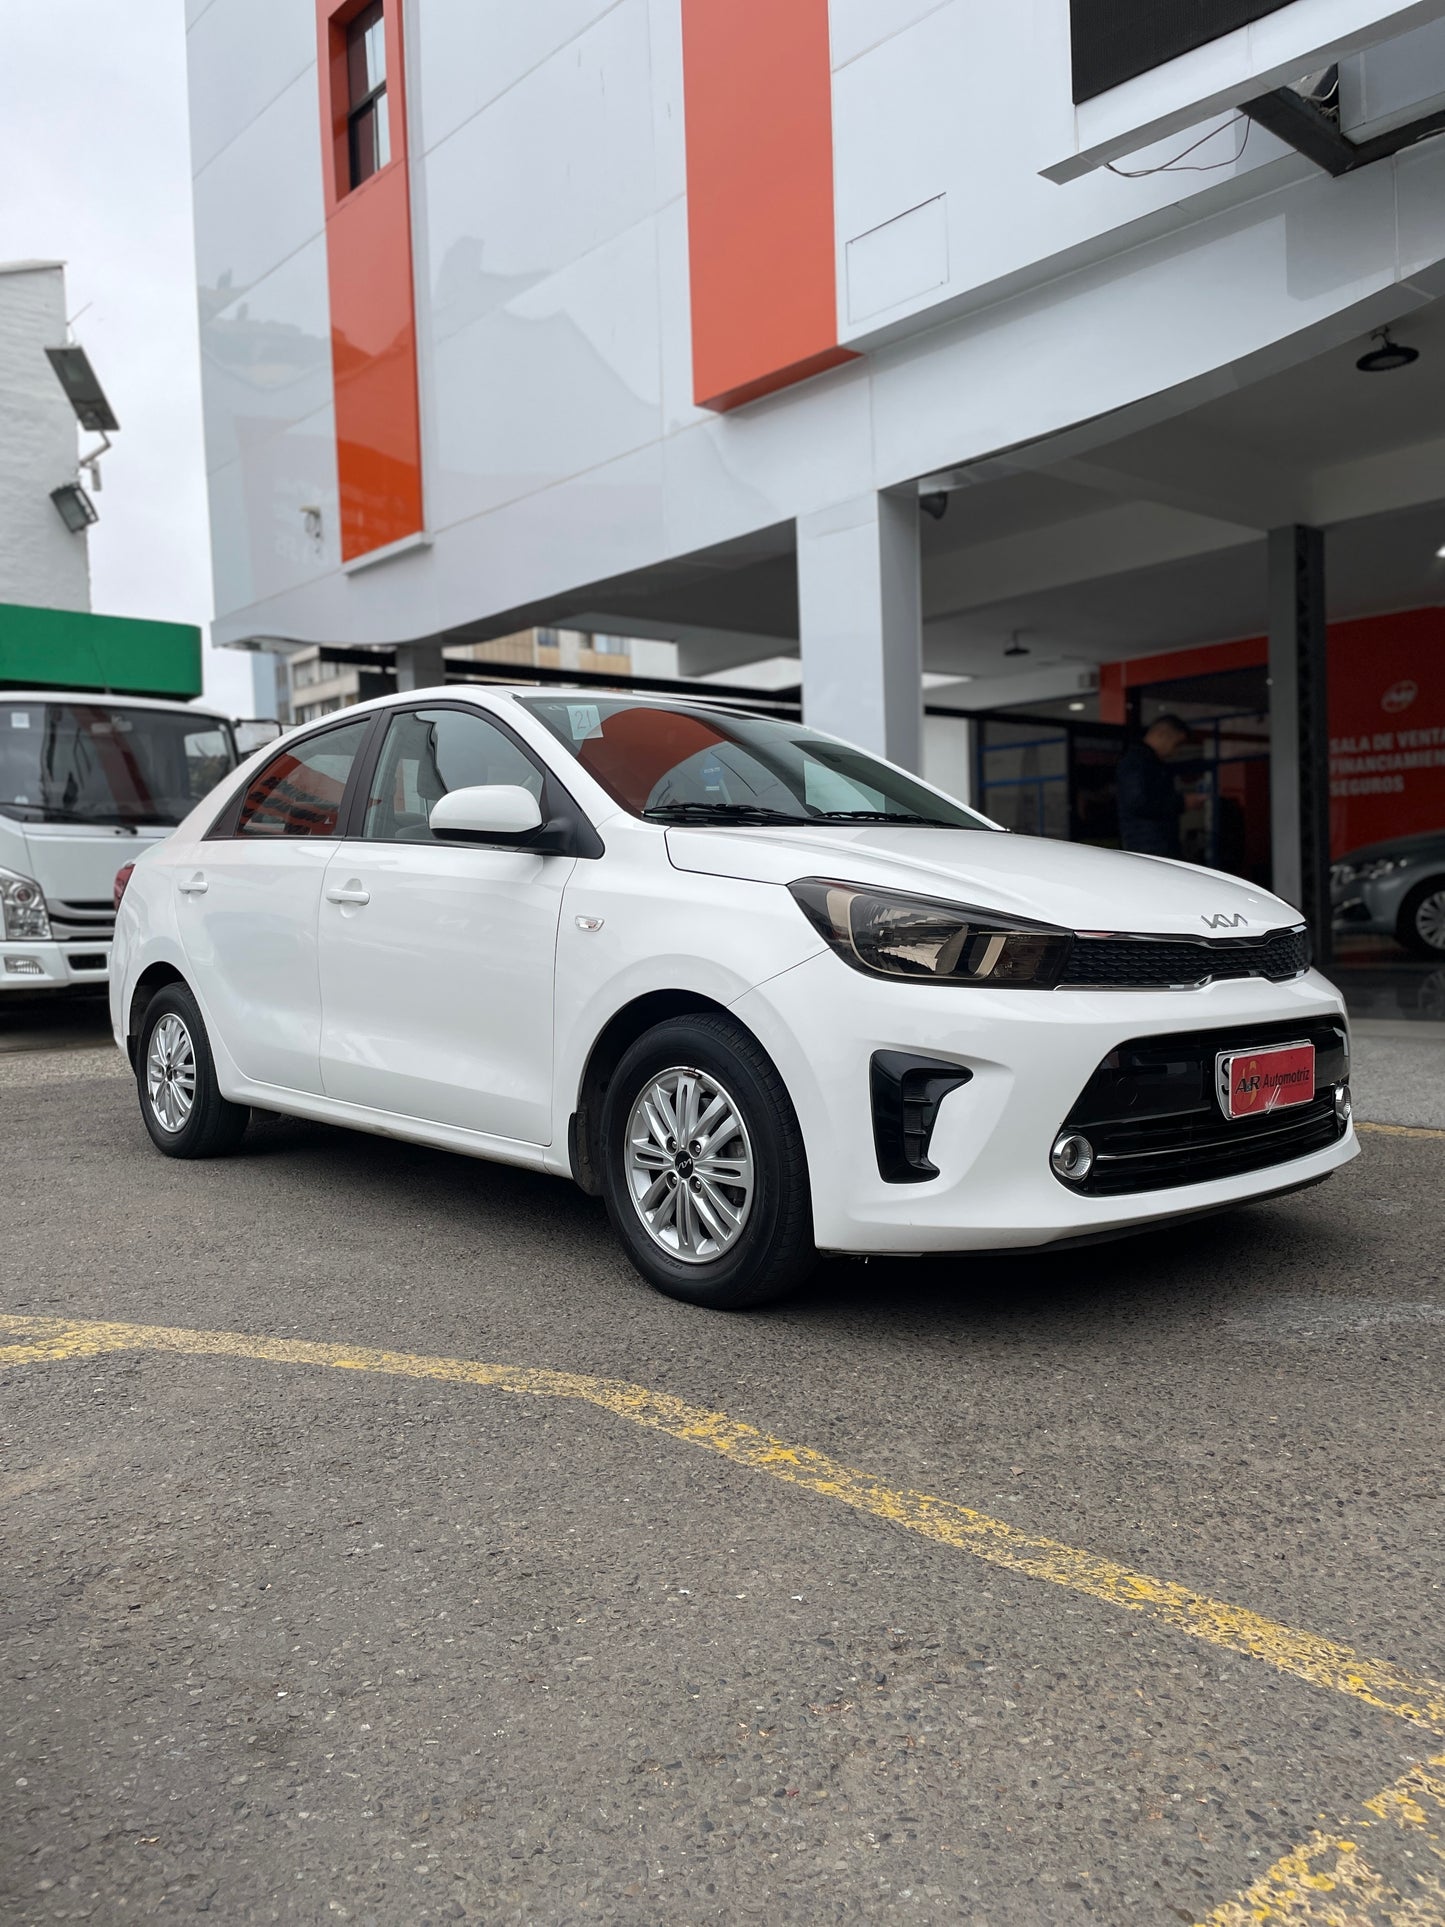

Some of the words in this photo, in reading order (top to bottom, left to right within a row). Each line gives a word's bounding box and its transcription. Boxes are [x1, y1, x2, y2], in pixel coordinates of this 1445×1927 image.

[574, 709, 592, 730] 21
[1329, 736, 1370, 754] SALA
[1372, 732, 1394, 751] DE
[1329, 774, 1404, 796] SEGUROS
[1262, 1067, 1310, 1088] Automotriz
